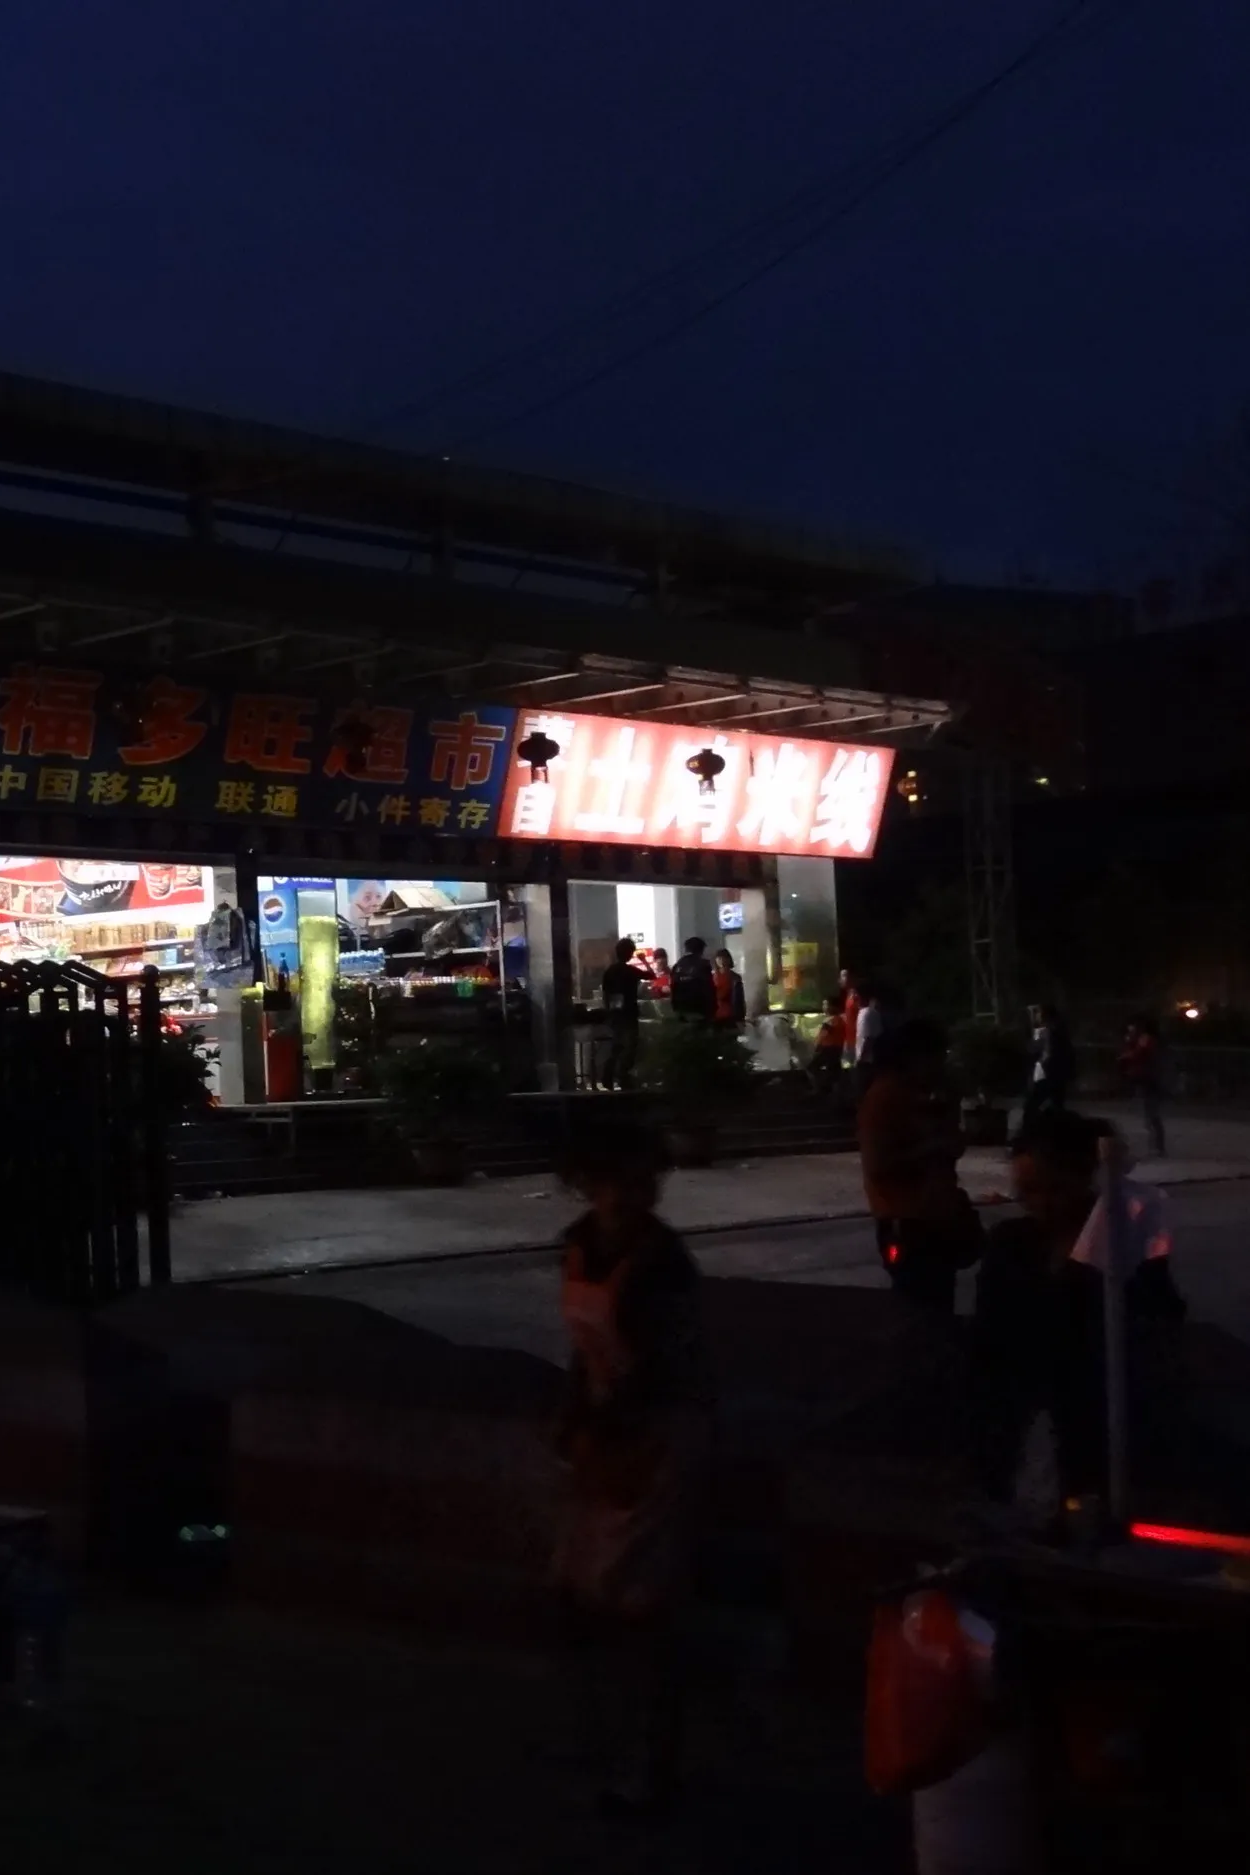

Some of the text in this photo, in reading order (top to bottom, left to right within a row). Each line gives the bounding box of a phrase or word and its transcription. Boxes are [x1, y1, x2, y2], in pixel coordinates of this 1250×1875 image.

[214, 778, 299, 819] 联通
[334, 791, 491, 831] 小件寄存
